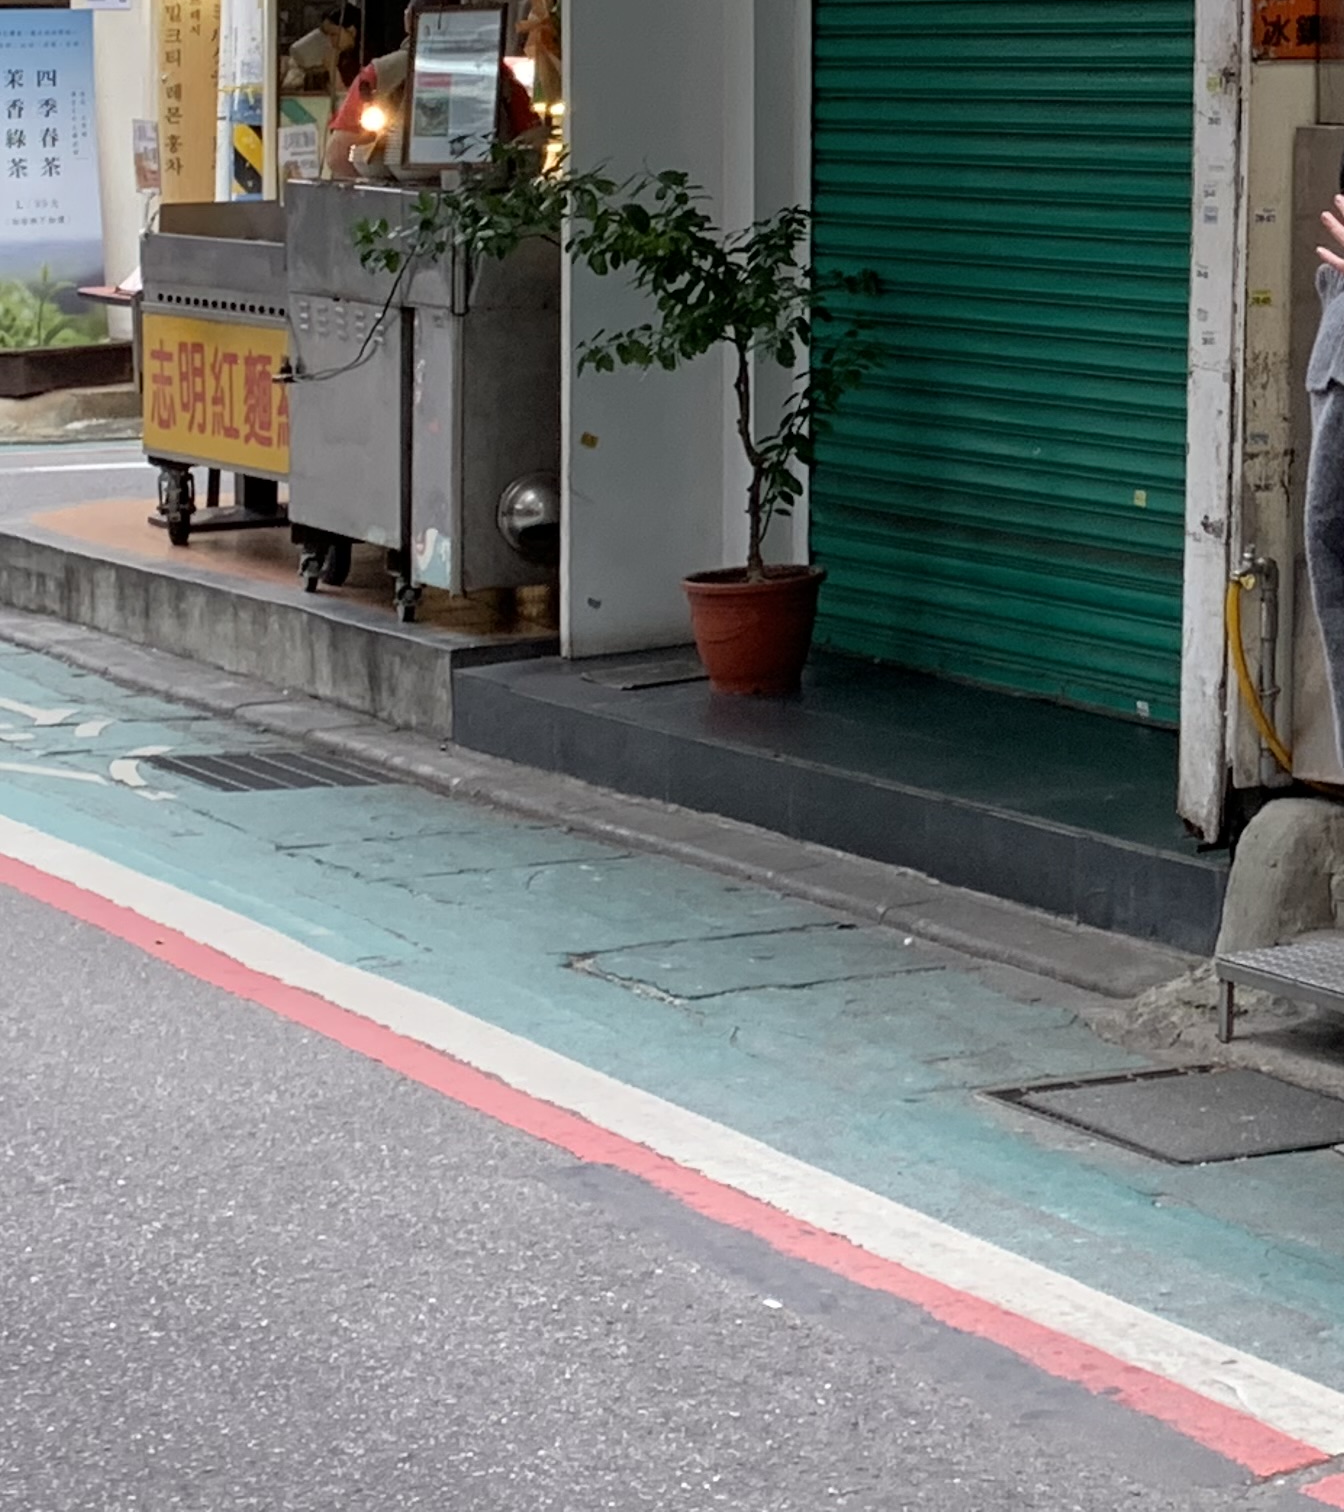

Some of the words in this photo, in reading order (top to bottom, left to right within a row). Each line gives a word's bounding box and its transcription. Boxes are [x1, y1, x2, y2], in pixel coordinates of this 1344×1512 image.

[36, 69, 62, 177] 四季春茶
[150, 338, 290, 449] 志明紅麵
